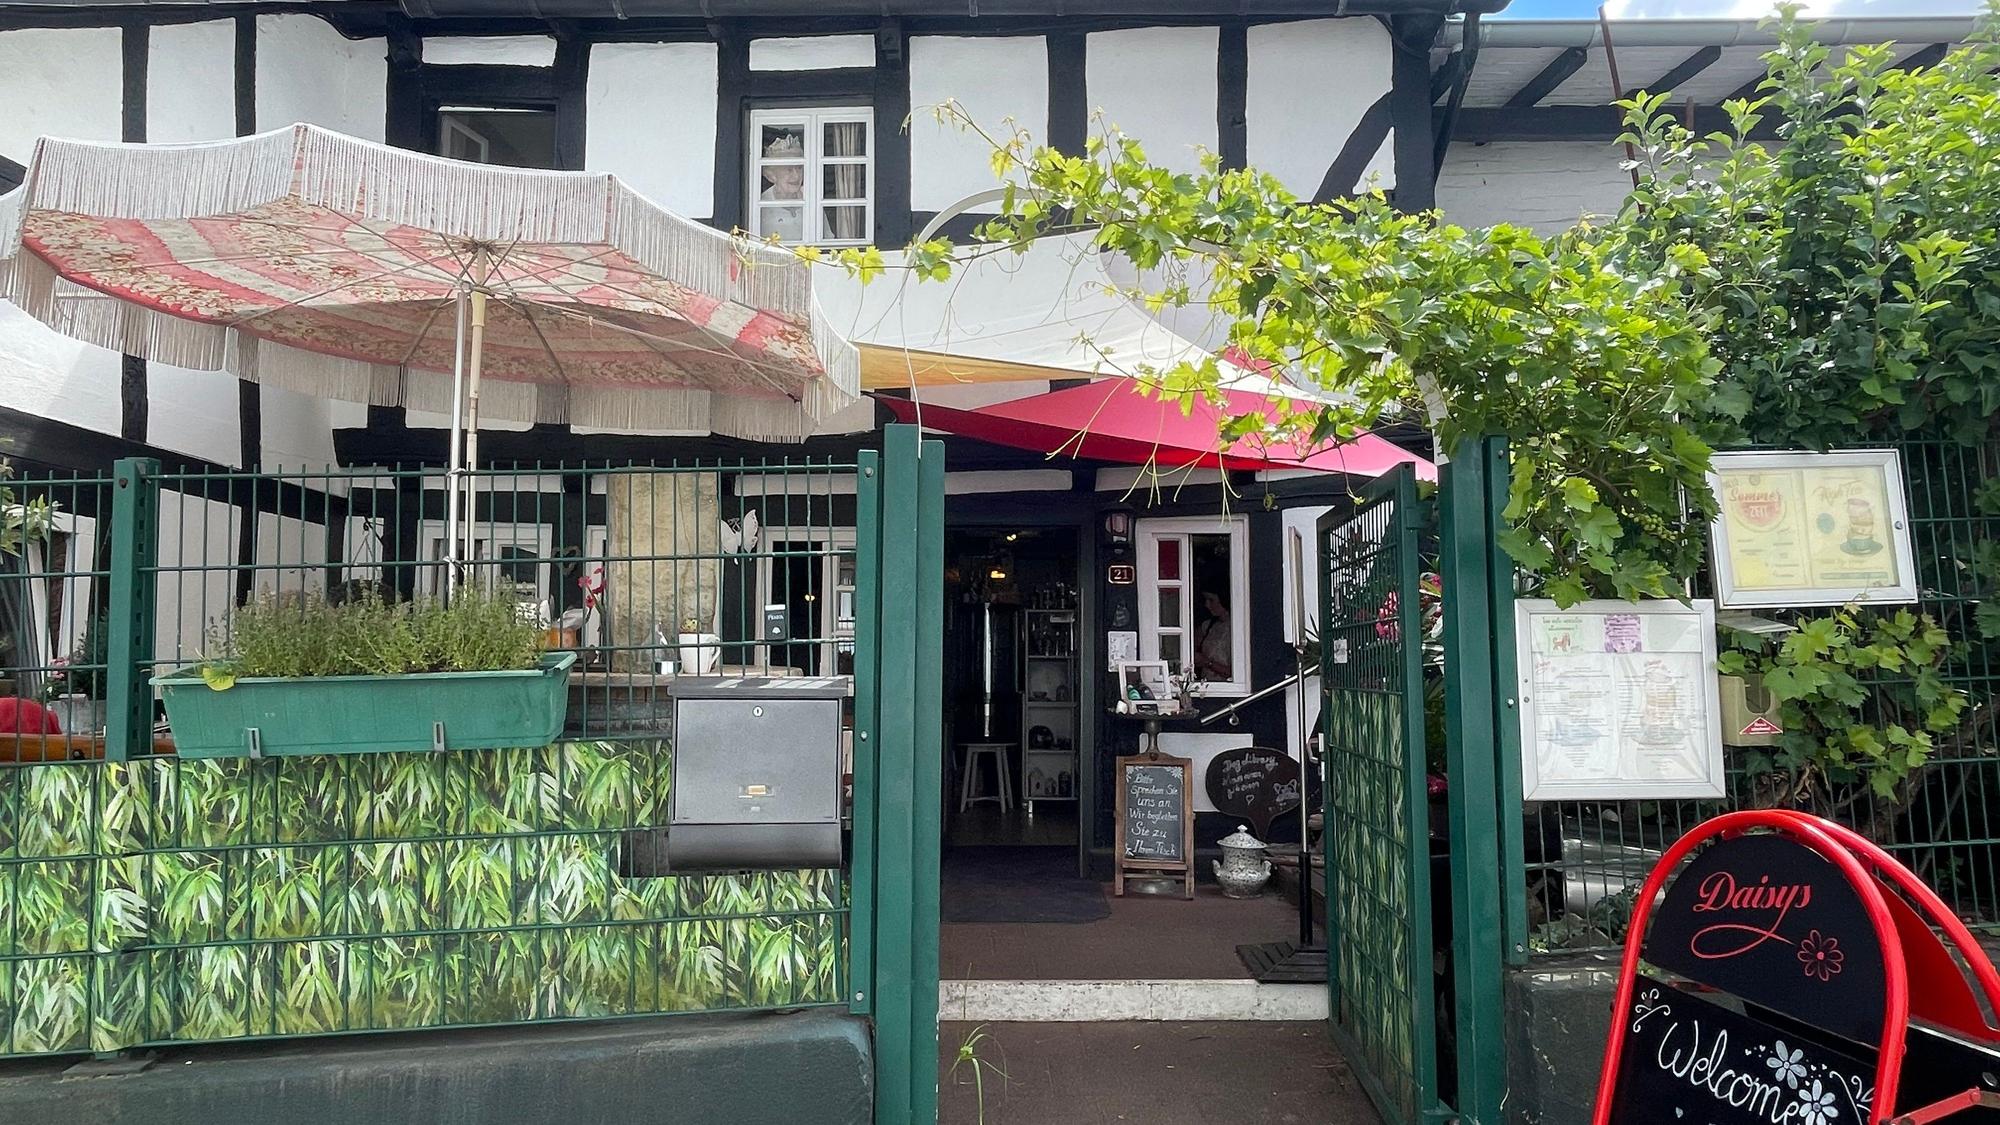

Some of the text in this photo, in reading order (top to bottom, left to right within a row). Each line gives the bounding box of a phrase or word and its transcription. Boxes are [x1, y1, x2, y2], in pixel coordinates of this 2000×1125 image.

[1113, 569, 1129, 580] 21
[1129, 807, 1145, 819] Wir
[1131, 821, 1167, 839] Sie zu
[1658, 1020, 1801, 1125] Welcome
